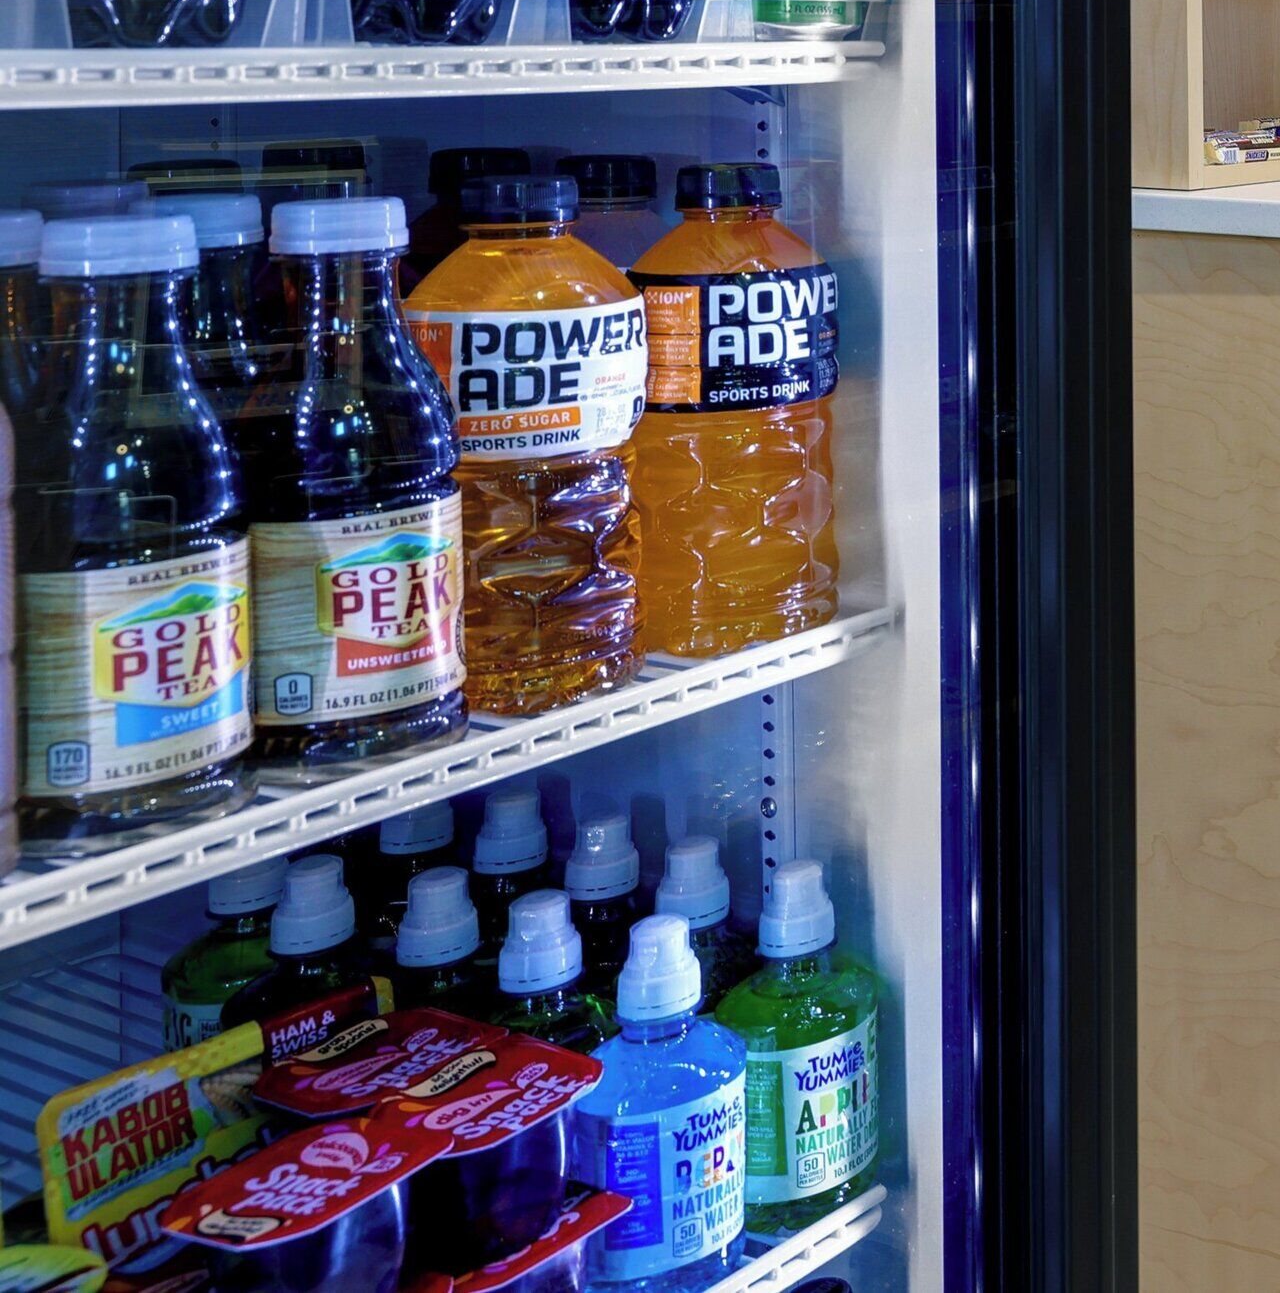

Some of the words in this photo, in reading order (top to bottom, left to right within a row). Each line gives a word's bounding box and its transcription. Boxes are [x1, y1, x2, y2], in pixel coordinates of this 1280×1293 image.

[709, 272, 838, 325] POWE
[461, 308, 643, 366] POWER
[708, 319, 810, 368] ADE
[459, 362, 581, 412] ADE
[709, 387, 768, 403] SPORTS
[772, 380, 810, 398] DRINK
[470, 416, 512, 432] ZERO
[519, 409, 571, 429] SUGAR
[461, 435, 527, 452] SPORTS
[533, 429, 581, 446] DRINK
[342, 518, 383, 534] REAL
[128, 571, 171, 585] REAL
[331, 553, 448, 589] GOLD
[332, 572, 450, 627] PEAK
[112, 603, 241, 648] GOLD
[372, 619, 430, 639] TEA
[112, 623, 242, 692] PEAK
[157, 674, 218, 701] TEA
[289, 679, 298, 693] 0
[325, 697, 350, 710] 16.9
[353, 694, 367, 706] FL
[370, 690, 385, 703] OZ
[160, 701, 219, 729] SWEET
[53, 748, 84, 764] 170
[271, 1017, 315, 1045] HAM
[322, 1009, 336, 1025] &
[271, 1026, 328, 1059] SWISS
[339, 1040, 457, 1098] Snack
[794, 1051, 865, 1092] YUMMIES
[435, 1107, 469, 1129] dig
[452, 1076, 570, 1140] Snack
[497, 1077, 579, 1132] Pack
[60, 1080, 191, 1166] KABOB
[672, 1110, 743, 1152] YUMMIES
[796, 1108, 867, 1155] NATURALLY
[67, 1113, 198, 1203] ULATOR
[804, 1159, 819, 1172] 50
[826, 1131, 862, 1166] WATER
[243, 1164, 361, 1196] Snack
[673, 1166, 744, 1220] NATURALLY
[705, 1193, 739, 1232] WATER
[680, 1223, 696, 1240] 50
